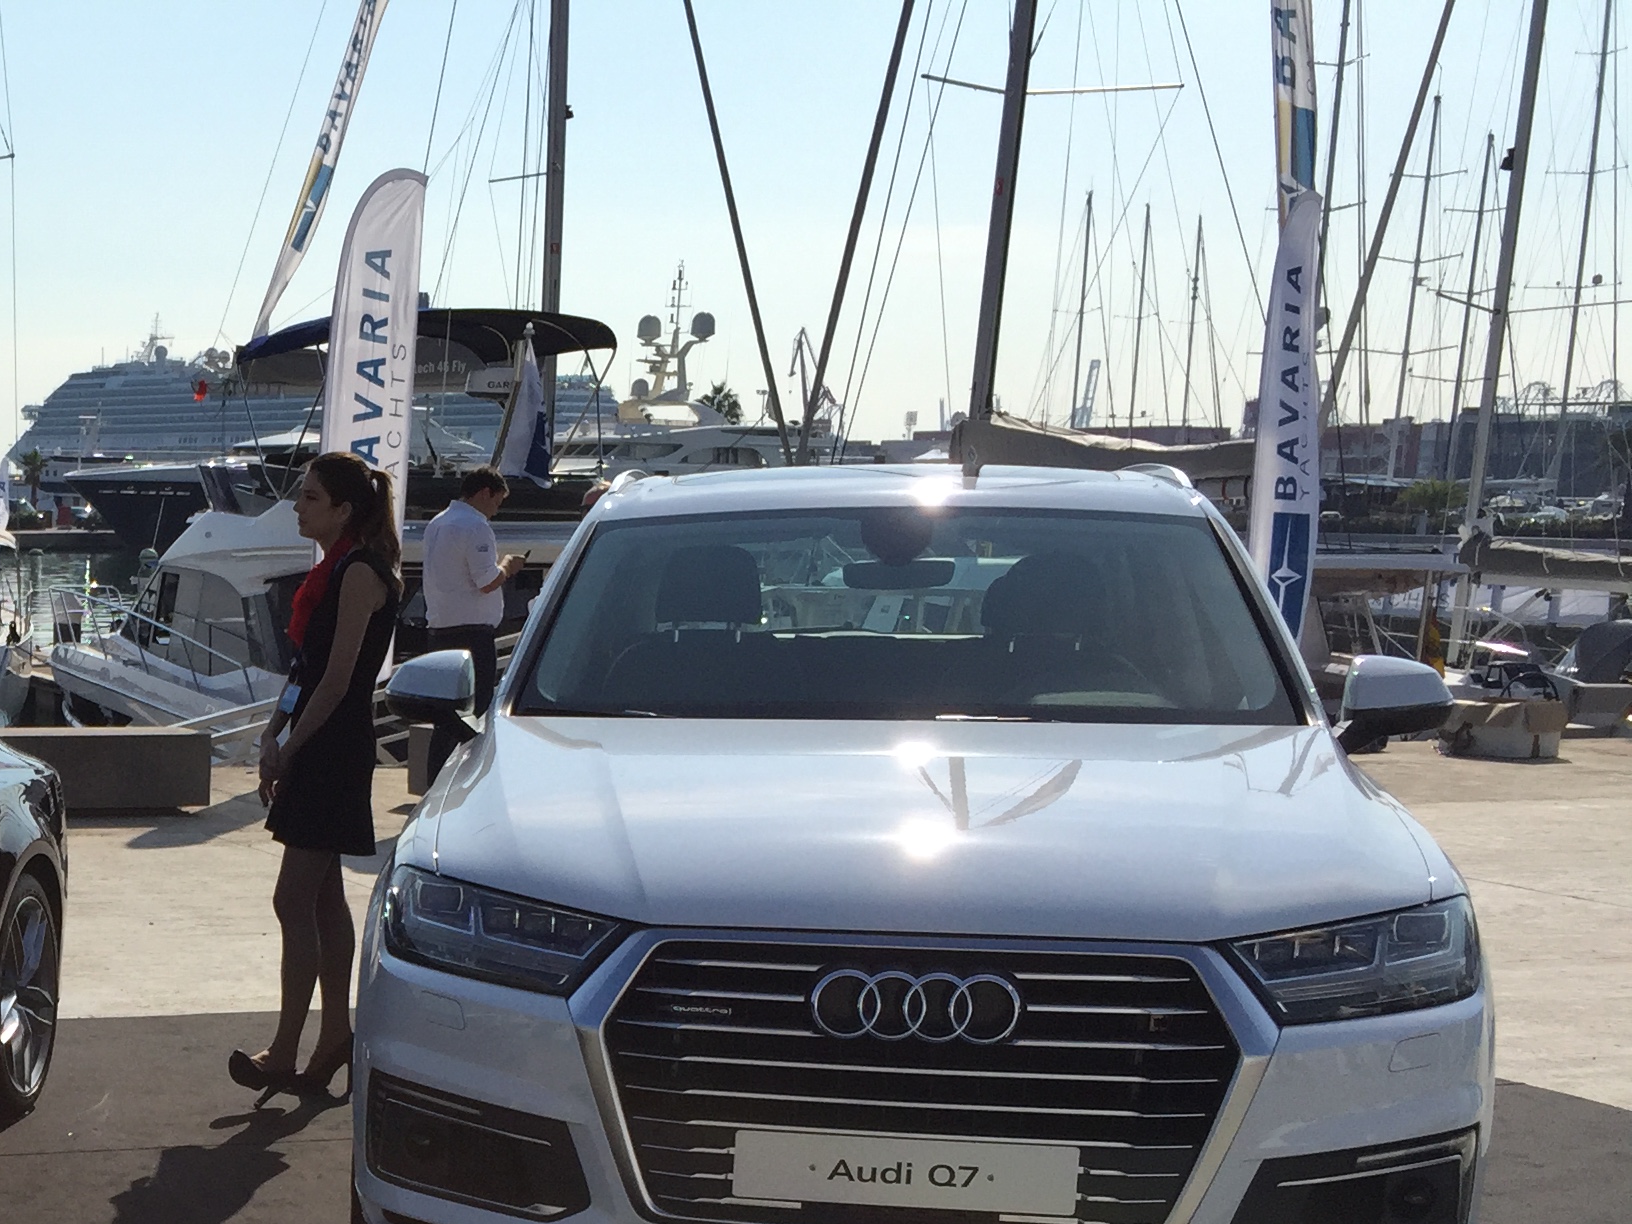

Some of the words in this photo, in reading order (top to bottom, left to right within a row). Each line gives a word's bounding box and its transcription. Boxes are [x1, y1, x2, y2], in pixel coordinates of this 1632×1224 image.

[350, 248, 393, 467] AVARIA
[384, 343, 407, 480] ACHTS
[1274, 265, 1303, 501] BAVARIA
[827, 1159, 912, 1185] Audi
[928, 1164, 980, 1188] Q7
